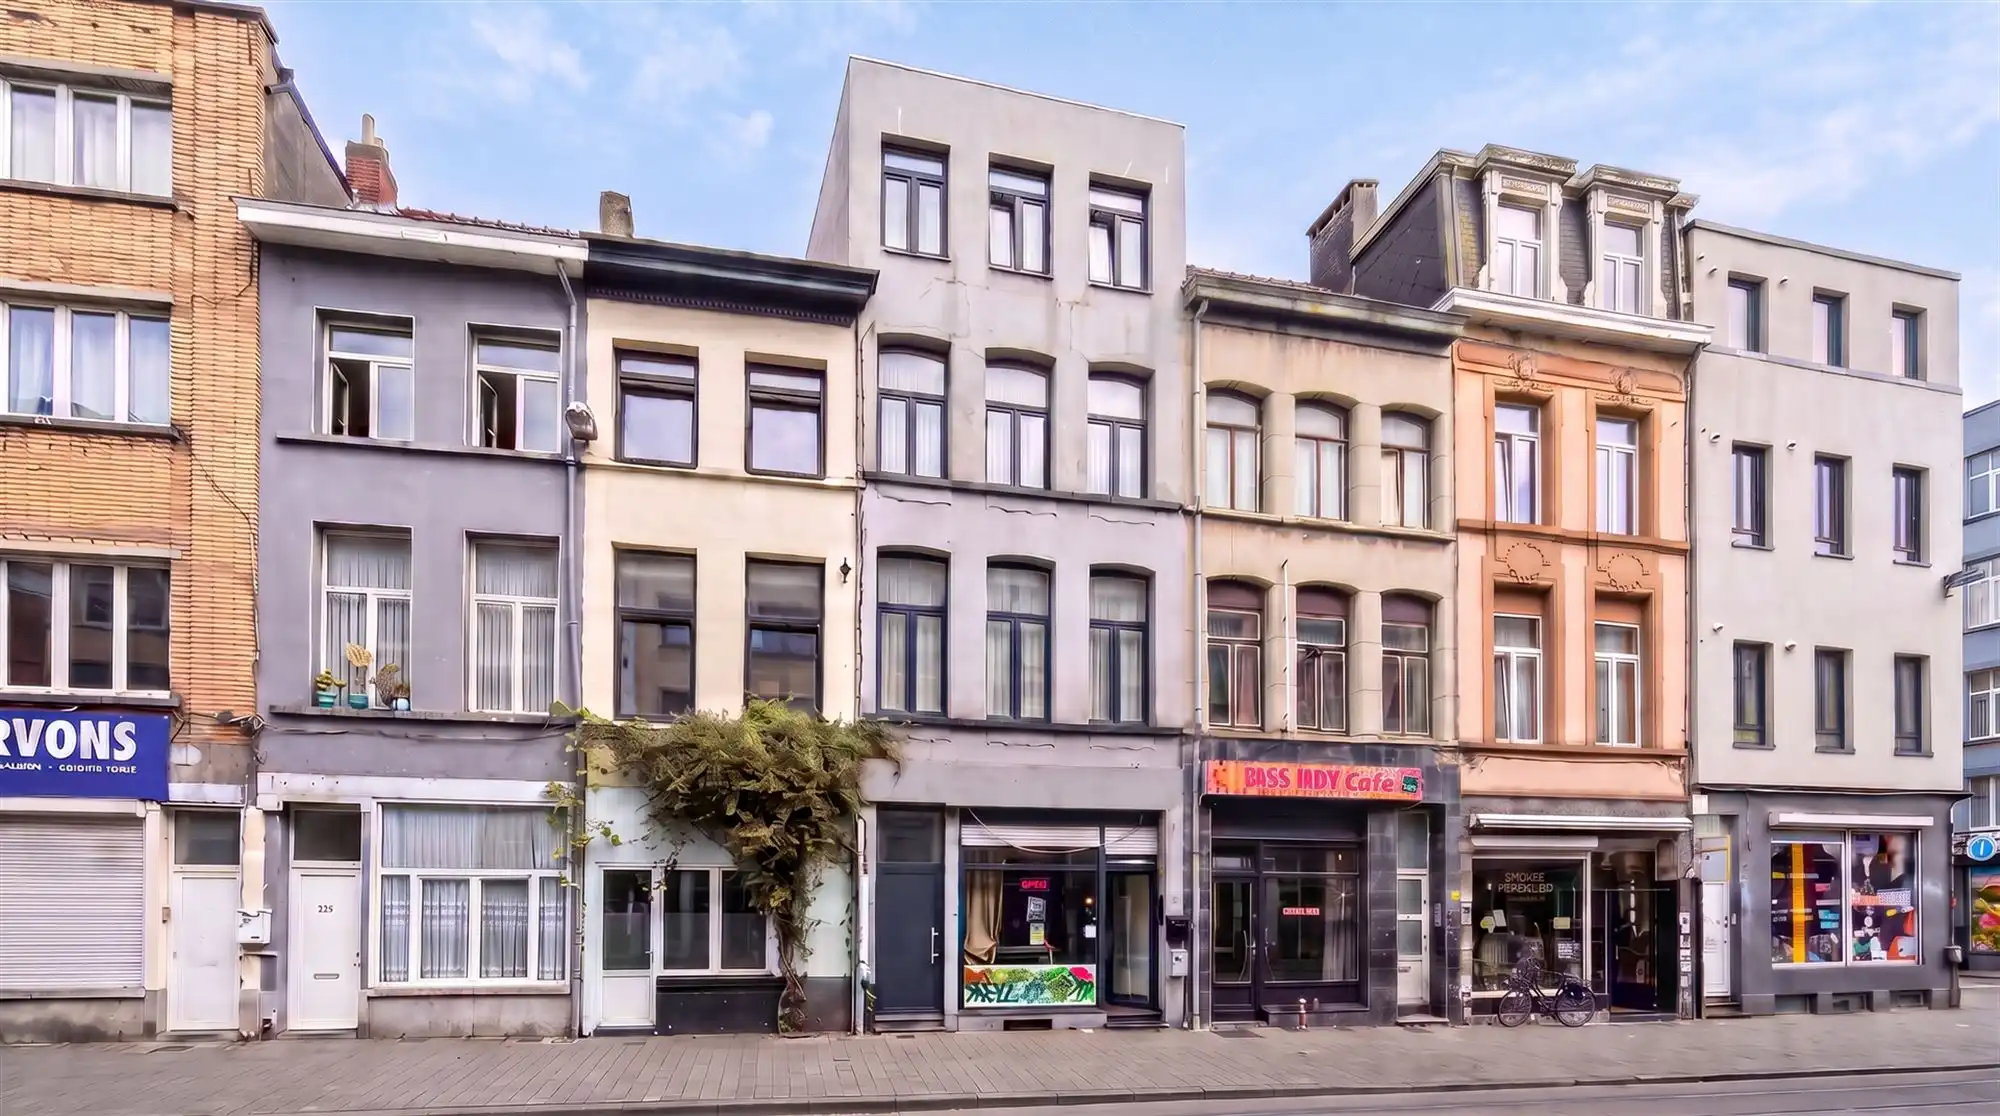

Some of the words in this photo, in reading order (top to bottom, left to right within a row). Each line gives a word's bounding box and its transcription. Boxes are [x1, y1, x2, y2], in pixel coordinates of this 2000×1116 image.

[1244, 766, 1290, 789] BASS
[1345, 772, 1394, 793] Cafe
[317, 904, 334, 913] 225
